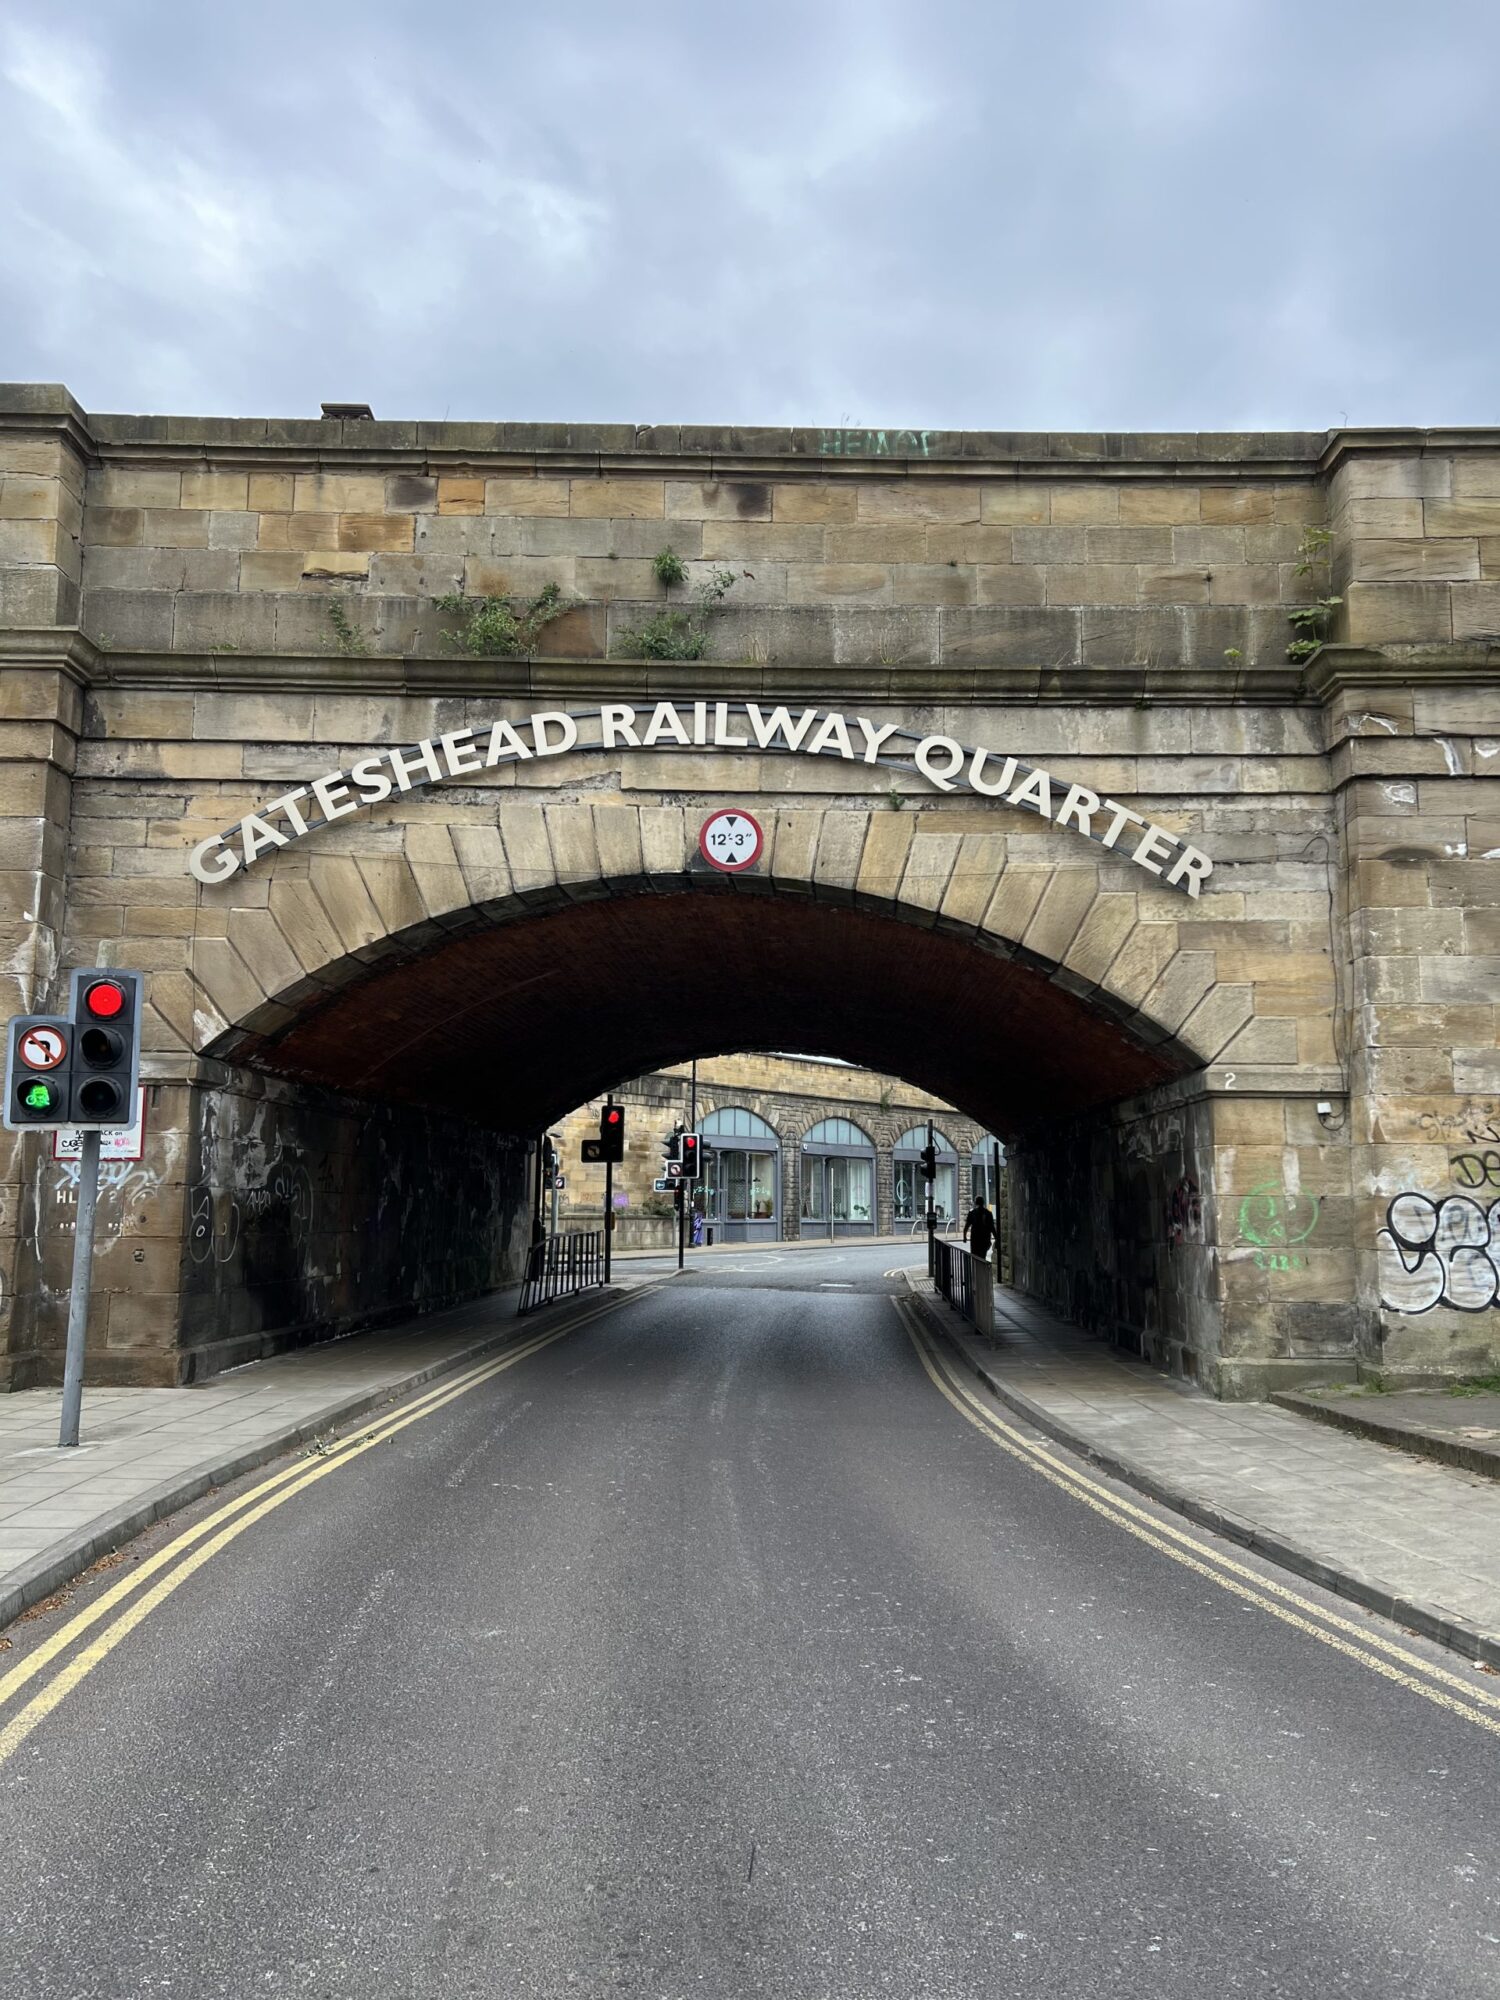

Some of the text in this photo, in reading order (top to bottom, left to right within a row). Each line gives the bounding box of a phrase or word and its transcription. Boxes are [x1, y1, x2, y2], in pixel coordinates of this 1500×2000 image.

[189, 701, 1214, 900] GATESHEAD RAILWAY QUARTER
[1224, 1072, 1236, 1089] 2
